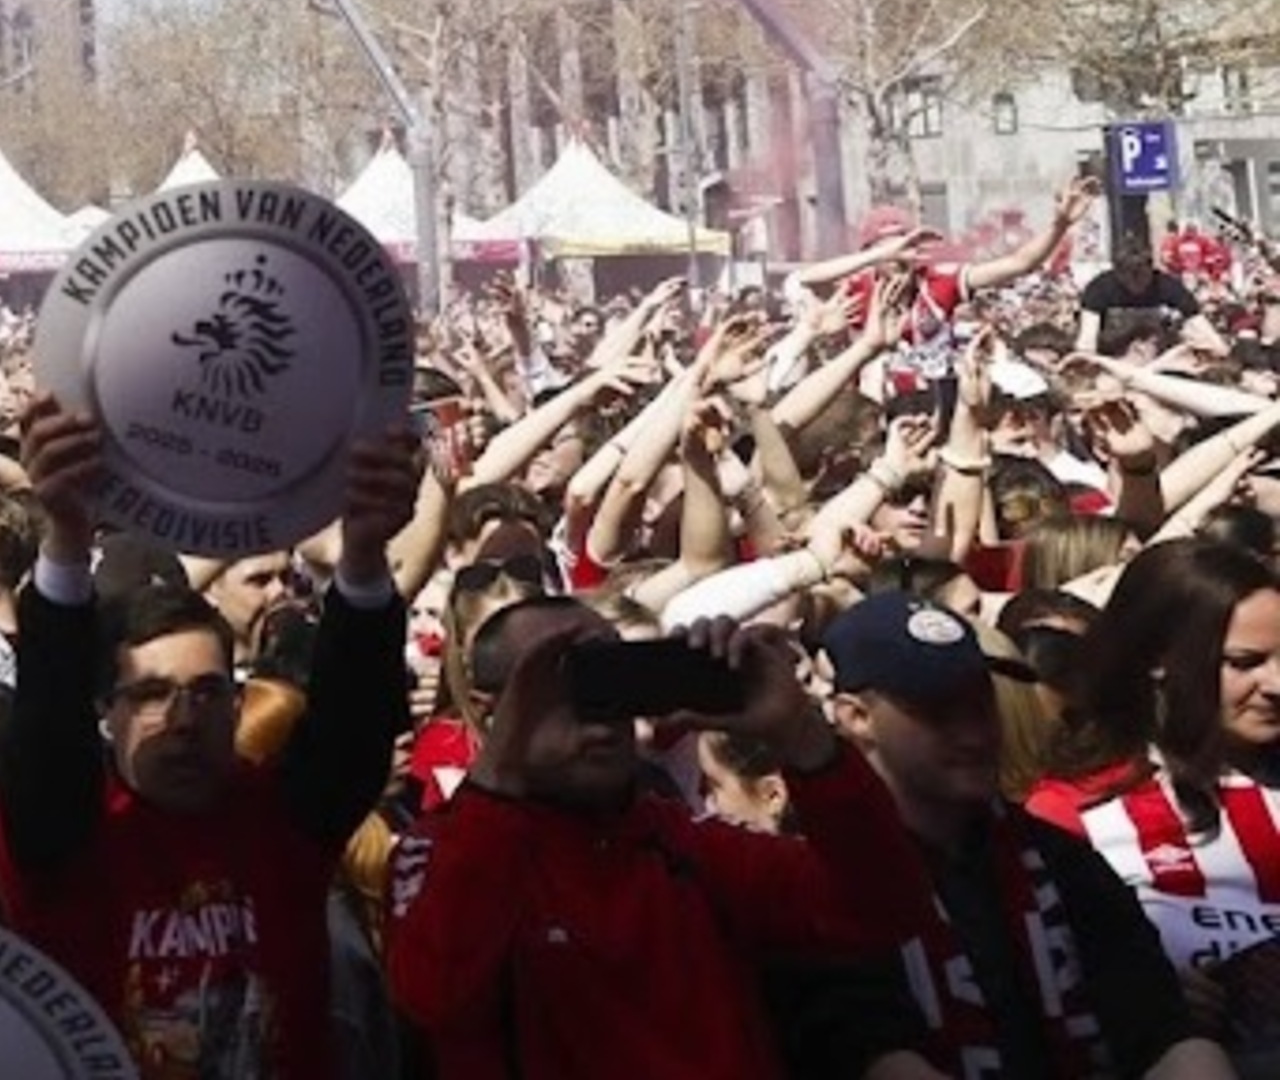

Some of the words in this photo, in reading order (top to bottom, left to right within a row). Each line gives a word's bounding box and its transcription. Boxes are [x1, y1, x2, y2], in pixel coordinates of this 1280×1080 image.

[1122, 135, 1141, 173] P
[61, 189, 223, 306] KAMPIOEN
[235, 189, 309, 229] VAN
[307, 213, 410, 388] NEDERLAND
[172, 389, 263, 433] KNVB
